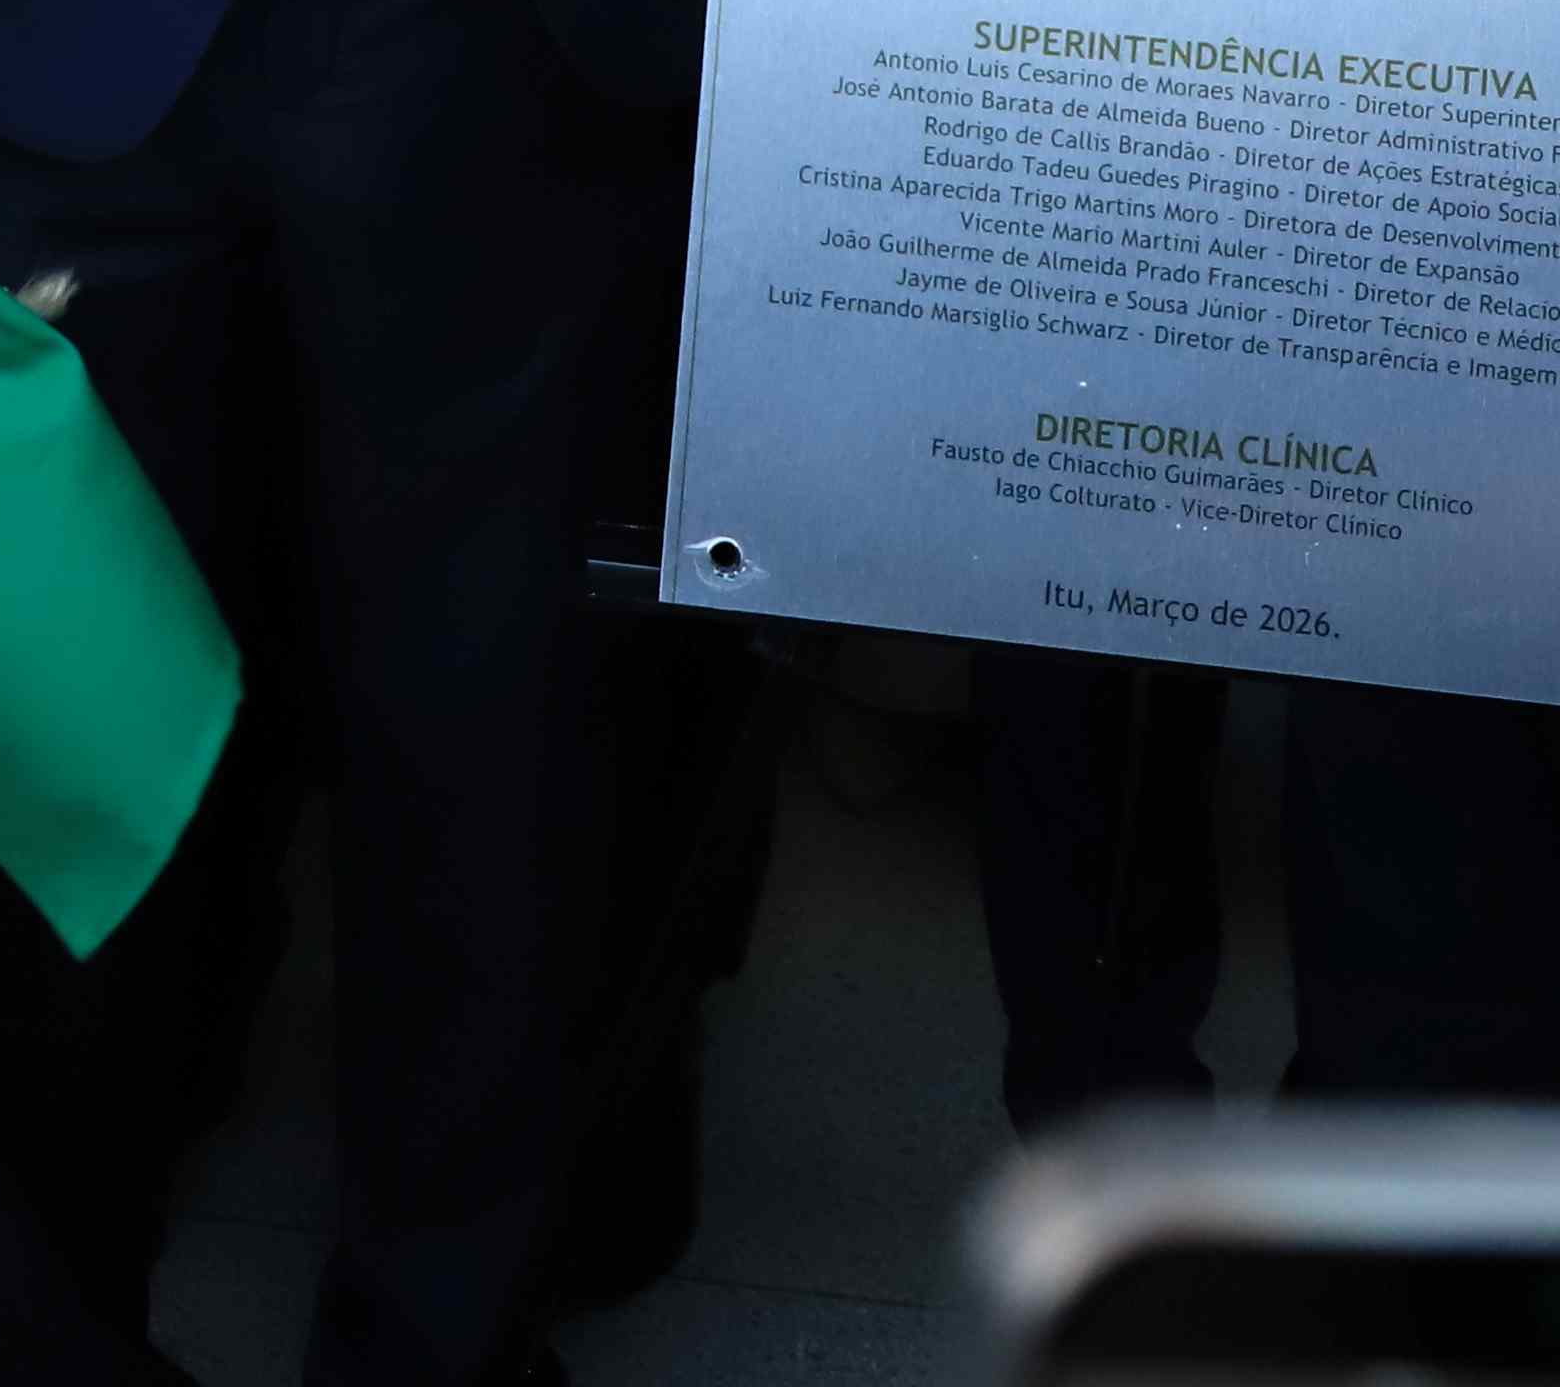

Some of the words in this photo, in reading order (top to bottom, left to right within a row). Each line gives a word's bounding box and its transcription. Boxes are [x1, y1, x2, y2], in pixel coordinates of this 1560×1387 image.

[872, 48, 960, 76] Antonio
[965, 55, 1011, 81] Luis
[1016, 60, 1114, 91] Cesarino
[1119, 71, 1150, 94] de
[1154, 74, 1236, 102] Moraes
[1241, 81, 1332, 112] Navarro
[1354, 92, 1437, 121] Diretor
[972, 19, 1325, 83] SUPERINTENDÊNCIA
[1337, 53, 1538, 103] EXECUTIVA
[831, 75, 882, 99] José
[886, 81, 975, 109] Antonio
[980, 88, 1055, 117] Barata
[1060, 96, 1090, 120] de
[1095, 100, 1188, 130] Almeida
[1195, 109, 1266, 137] Bueno
[1288, 118, 1373, 147] Diretor
[1374, 126, 1545, 164] Administrativo
[797, 163, 884, 193] Cristina
[889, 173, 1002, 205] Aparecida
[1008, 184, 1068, 215] Trigo
[1073, 191, 1161, 221] Martins
[1161, 199, 1220, 227] Moro
[1242, 207, 1338, 238] Diretora
[1343, 218, 1374, 242] de
[818, 226, 872, 252] João
[877, 232, 996, 265] Guilherme
[1000, 244, 1031, 269] de
[1035, 249, 1128, 279] Almeida
[1134, 257, 1202, 286] Prado
[1206, 265, 1330, 299] Franceschi
[1353, 279, 1438, 309] Diretor
[1442, 289, 1472, 314] de
[894, 265, 970, 295] Jayme
[972, 273, 1004, 298] de
[1008, 276, 1098, 307] Oliveira
[1103, 291, 1120, 310] e
[1123, 288, 1190, 317] Sousa
[1195, 296, 1269, 325] Júnior
[1291, 306, 1374, 335] Diretor
[1377, 314, 1469, 345] Técnico
[1475, 329, 1492, 348] e
[767, 283, 814, 309] Luiz
[819, 289, 926, 320] Fernando
[929, 300, 1031, 334] Marsiglio
[1035, 311, 1130, 342] Schwarz
[1153, 323, 1236, 353] Diretor
[1240, 332, 1272, 357] de
[1276, 336, 1440, 375] Transparência
[1444, 358, 1462, 377] e
[1468, 355, 1559, 387] Imagem
[931, 436, 1006, 466] Fausto
[1010, 446, 1042, 471] de
[1046, 449, 1158, 483] Chiacchio
[1163, 462, 1286, 497] Guimarães
[1308, 478, 1391, 508] Diretor
[1395, 488, 1474, 517] Clínico
[1035, 411, 1225, 464] DIRETORIA
[1237, 431, 1380, 479] CLÍNICA
[995, 476, 1043, 504] Iago
[1047, 482, 1158, 514] Colturato
[1178, 495, 1323, 532] Vice-Diretor
[1324, 512, 1404, 541] Clínico
[1043, 578, 1095, 617] Itu,
[1106, 587, 1201, 629] Março
[1209, 598, 1249, 629] de
[1257, 603, 1341, 640] 2026.
